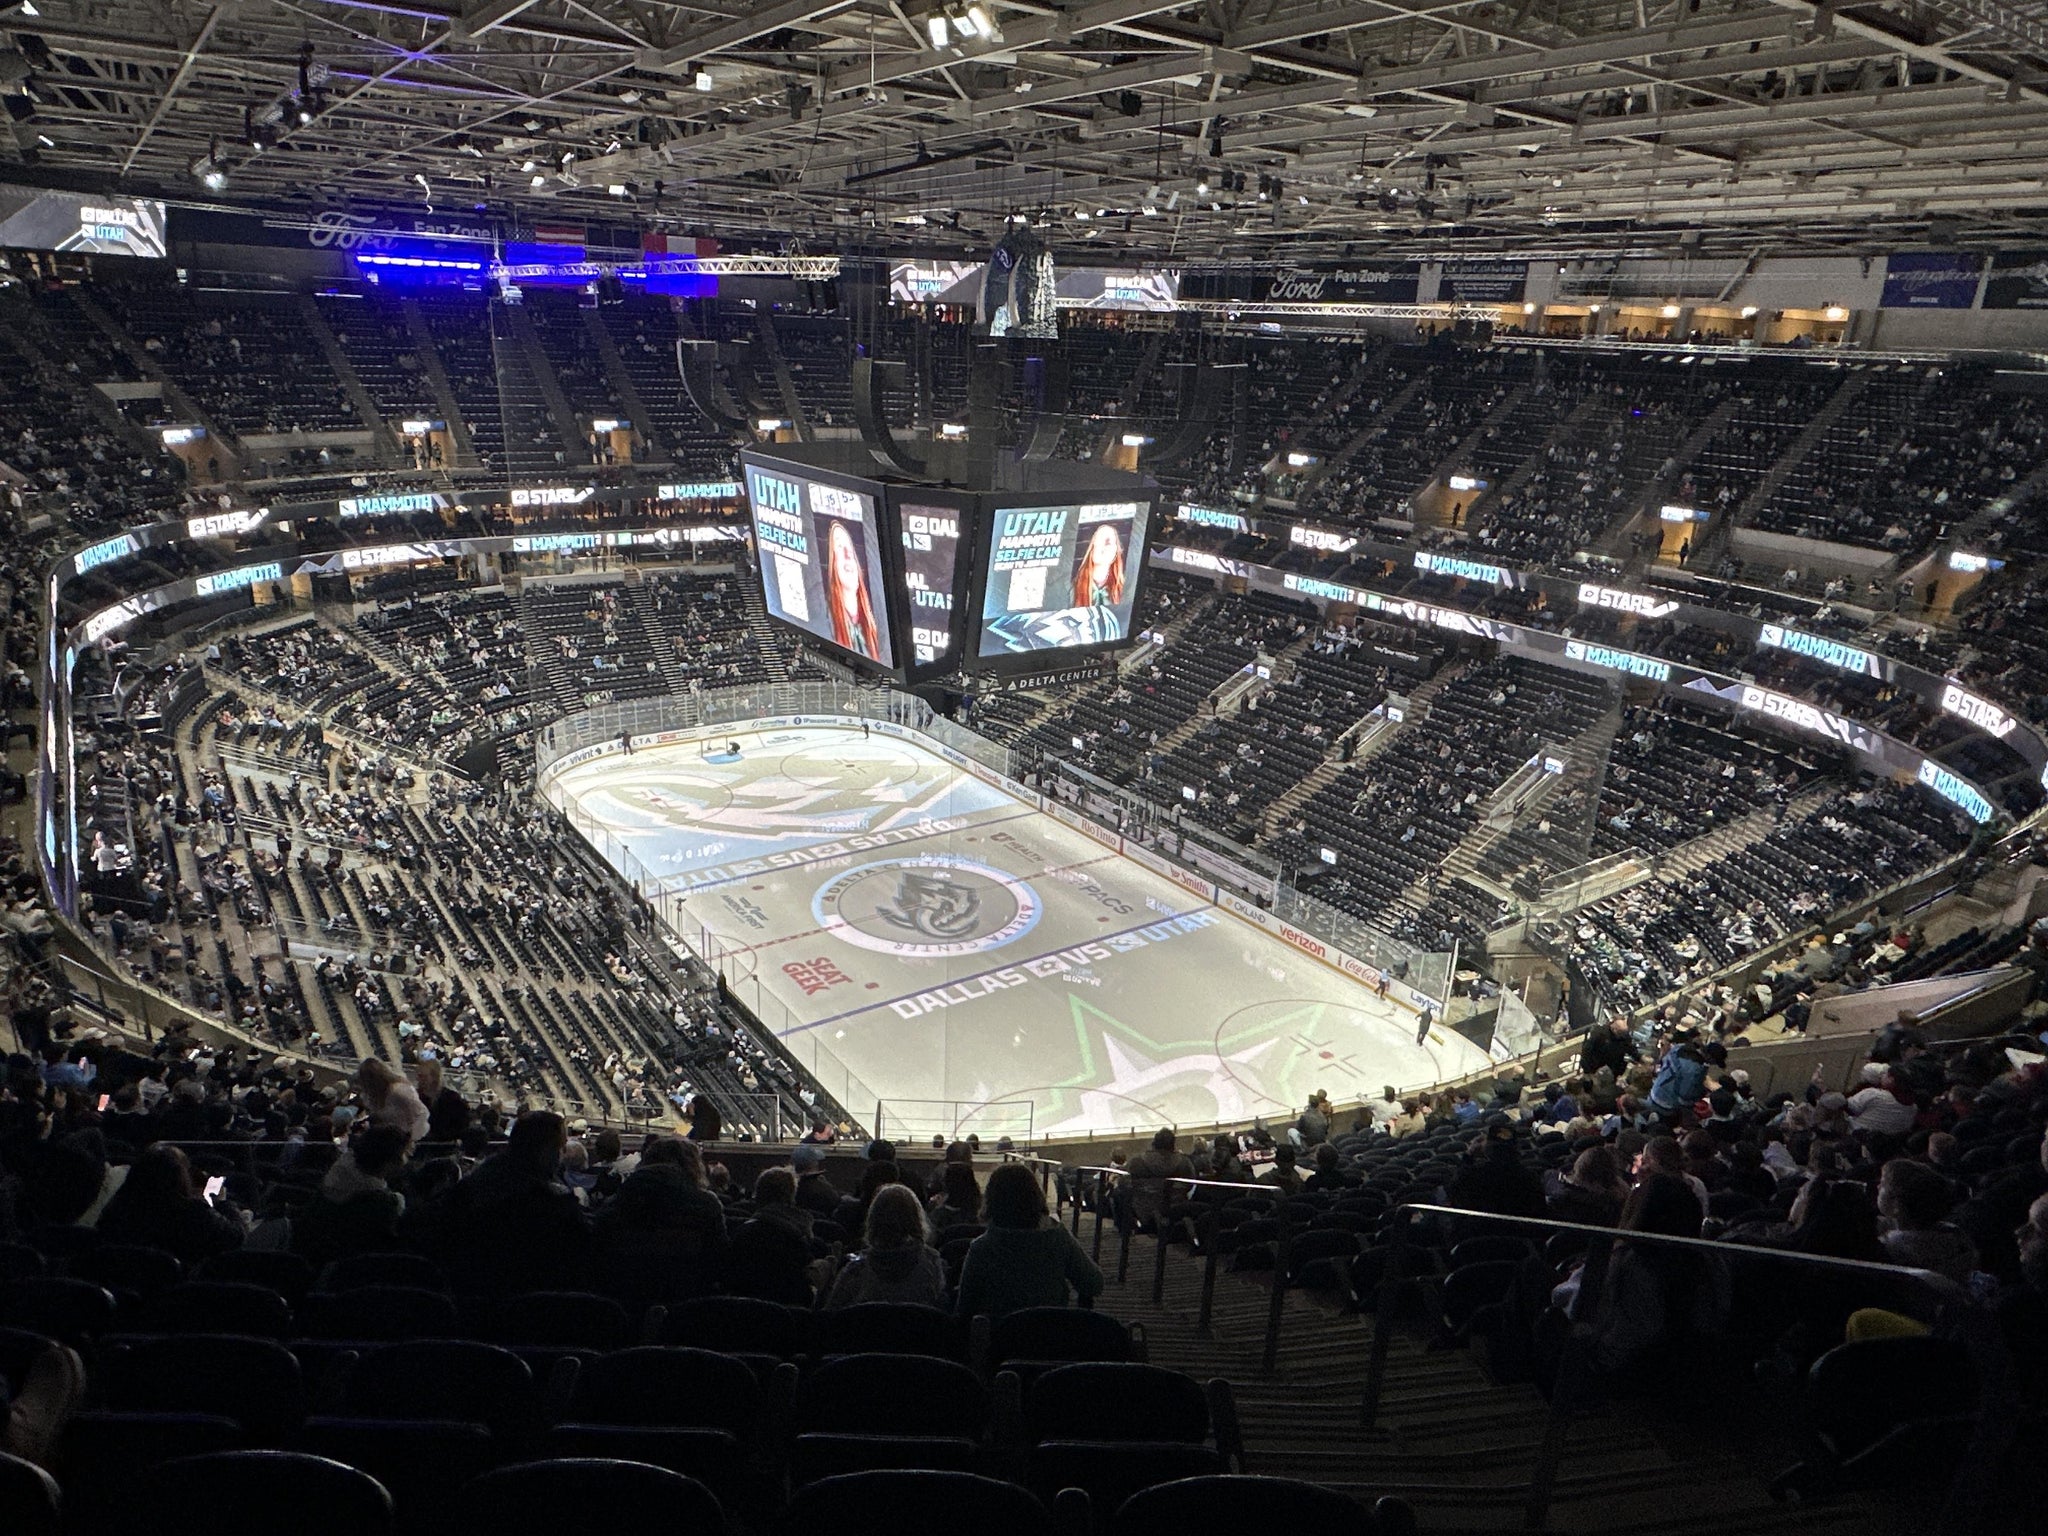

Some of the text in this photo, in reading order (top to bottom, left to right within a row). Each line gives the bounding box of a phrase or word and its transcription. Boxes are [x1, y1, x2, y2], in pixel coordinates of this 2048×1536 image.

[96, 226, 125, 240] UTAH
[308, 211, 399, 250] Ford
[414, 221, 490, 238] Fan Zone
[919, 282, 941, 292] UTAH
[1270, 268, 1326, 299] Ford
[1335, 269, 1390, 283] Fan Zone
[1117, 289, 1140, 299] UTAH
[357, 493, 433, 514] MAMMOTH
[530, 487, 576, 505] STARS
[676, 482, 737, 499] MAMMOTH
[754, 473, 800, 516] UTAH
[205, 511, 251, 534] STARS
[757, 504, 803, 534] MAMMOTH
[1004, 511, 1068, 537] UTAH
[1190, 507, 1239, 530] MAMMOTH
[758, 522, 808, 553] SELFIE CAM
[999, 534, 1061, 549] MAMMOTH
[1305, 530, 1341, 549] STARS
[83, 535, 129, 571] MAMMOTH
[995, 546, 1063, 562] SELFIE CAM
[212, 562, 282, 591] MAMMOTH
[1431, 555, 1500, 584] MAMMOTH
[1599, 588, 1655, 613] STARS
[1585, 645, 1670, 681] MAMMOTH
[1782, 629, 1869, 673] MAMMOTH
[1019, 667, 1100, 689] DELTA CENTER
[1762, 693, 1819, 728] STARS
[1958, 693, 2004, 733] STARS
[617, 737, 652, 749] DLTA
[570, 750, 595, 765] vivint
[1933, 767, 1993, 823] MAMMOTH
[849, 818, 957, 850] DALLAS
[768, 847, 822, 867] VS
[832, 866, 876, 895] DELTA
[1079, 884, 1134, 915] PACS
[1234, 900, 1266, 924] OKLAND
[894, 912, 1032, 953] DELTA CENTER
[1280, 924, 1326, 958] verizon
[806, 956, 854, 985] SEAT
[889, 967, 1028, 1020] DALLAS
[1061, 942, 1112, 965] VS
[1140, 911, 1221, 942] UTAH
[1345, 959, 1380, 984] Coca-Cola
[781, 962, 831, 996] GEEK
[1411, 990, 1442, 1014] Layton
